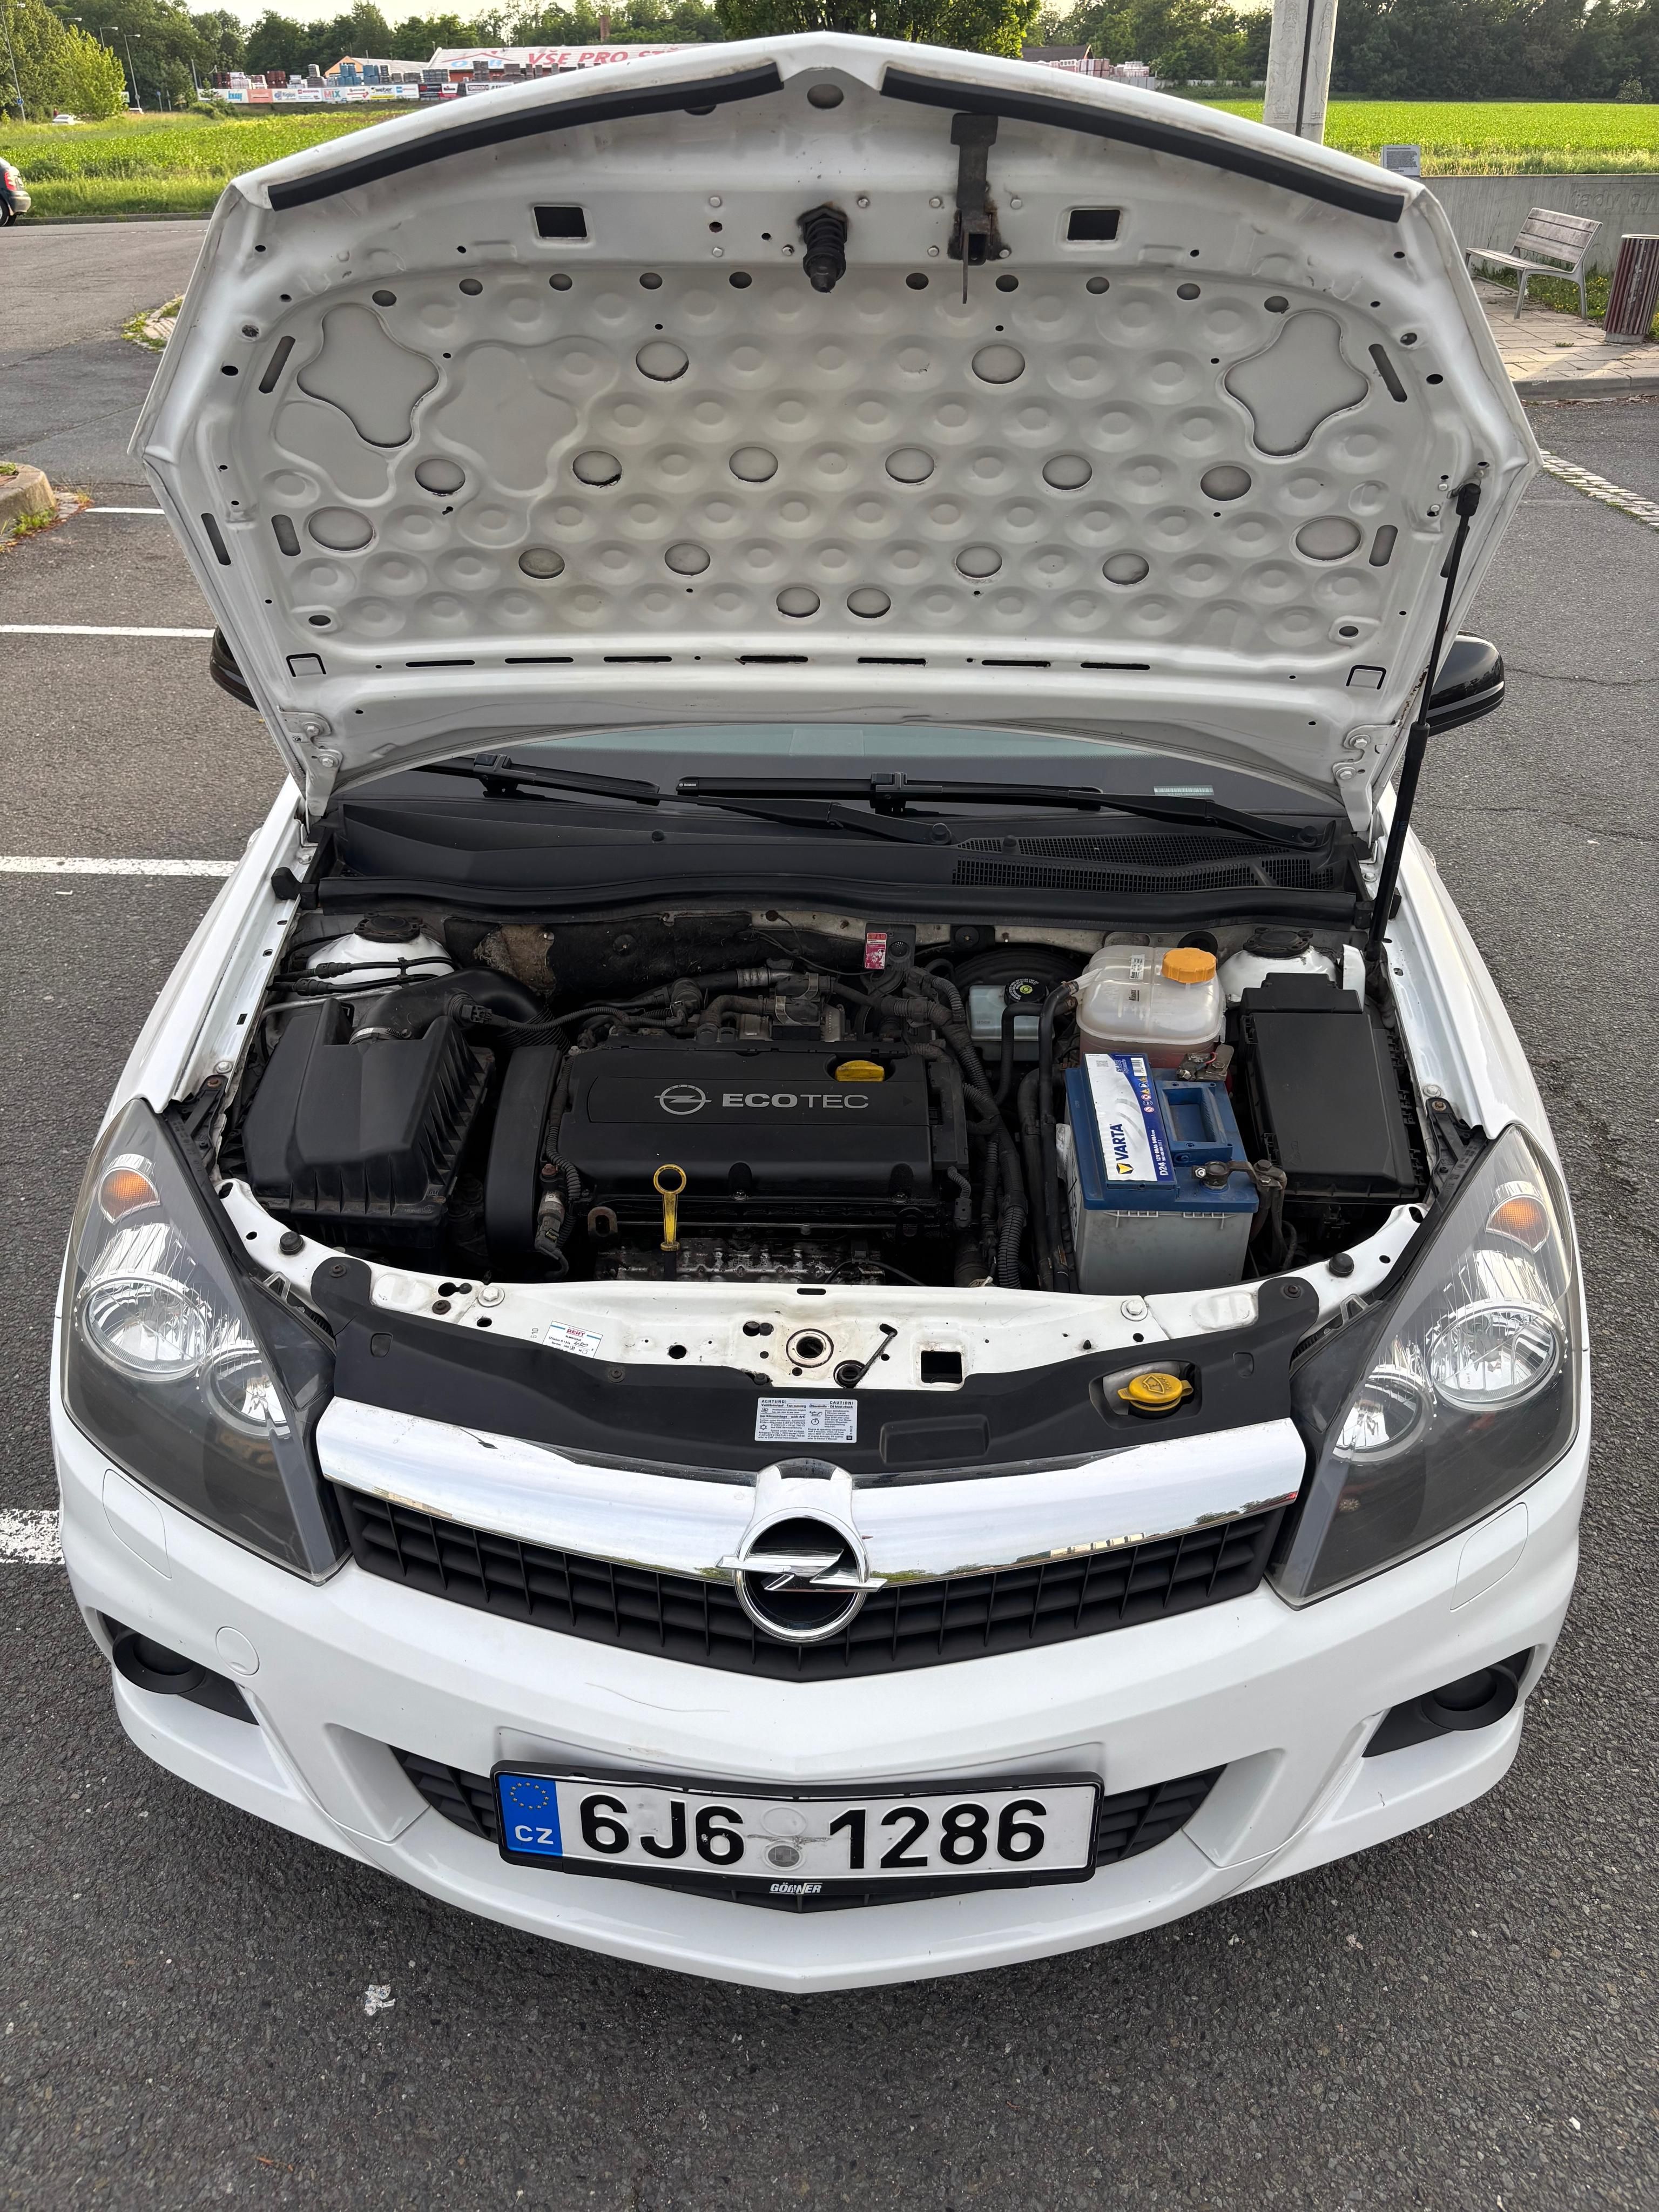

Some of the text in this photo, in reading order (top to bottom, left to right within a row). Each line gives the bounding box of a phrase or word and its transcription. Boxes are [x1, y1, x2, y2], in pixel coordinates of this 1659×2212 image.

[529, 50, 571, 65] VŠE
[578, 51, 629, 64] PRO
[722, 1093, 869, 1109] ECOTEC
[1110, 1124, 1129, 1161] VARTA
[1158, 1162, 1169, 1176] D24
[514, 1824, 554, 1845] CZ
[579, 1792, 1046, 1869] 6J6 1286
